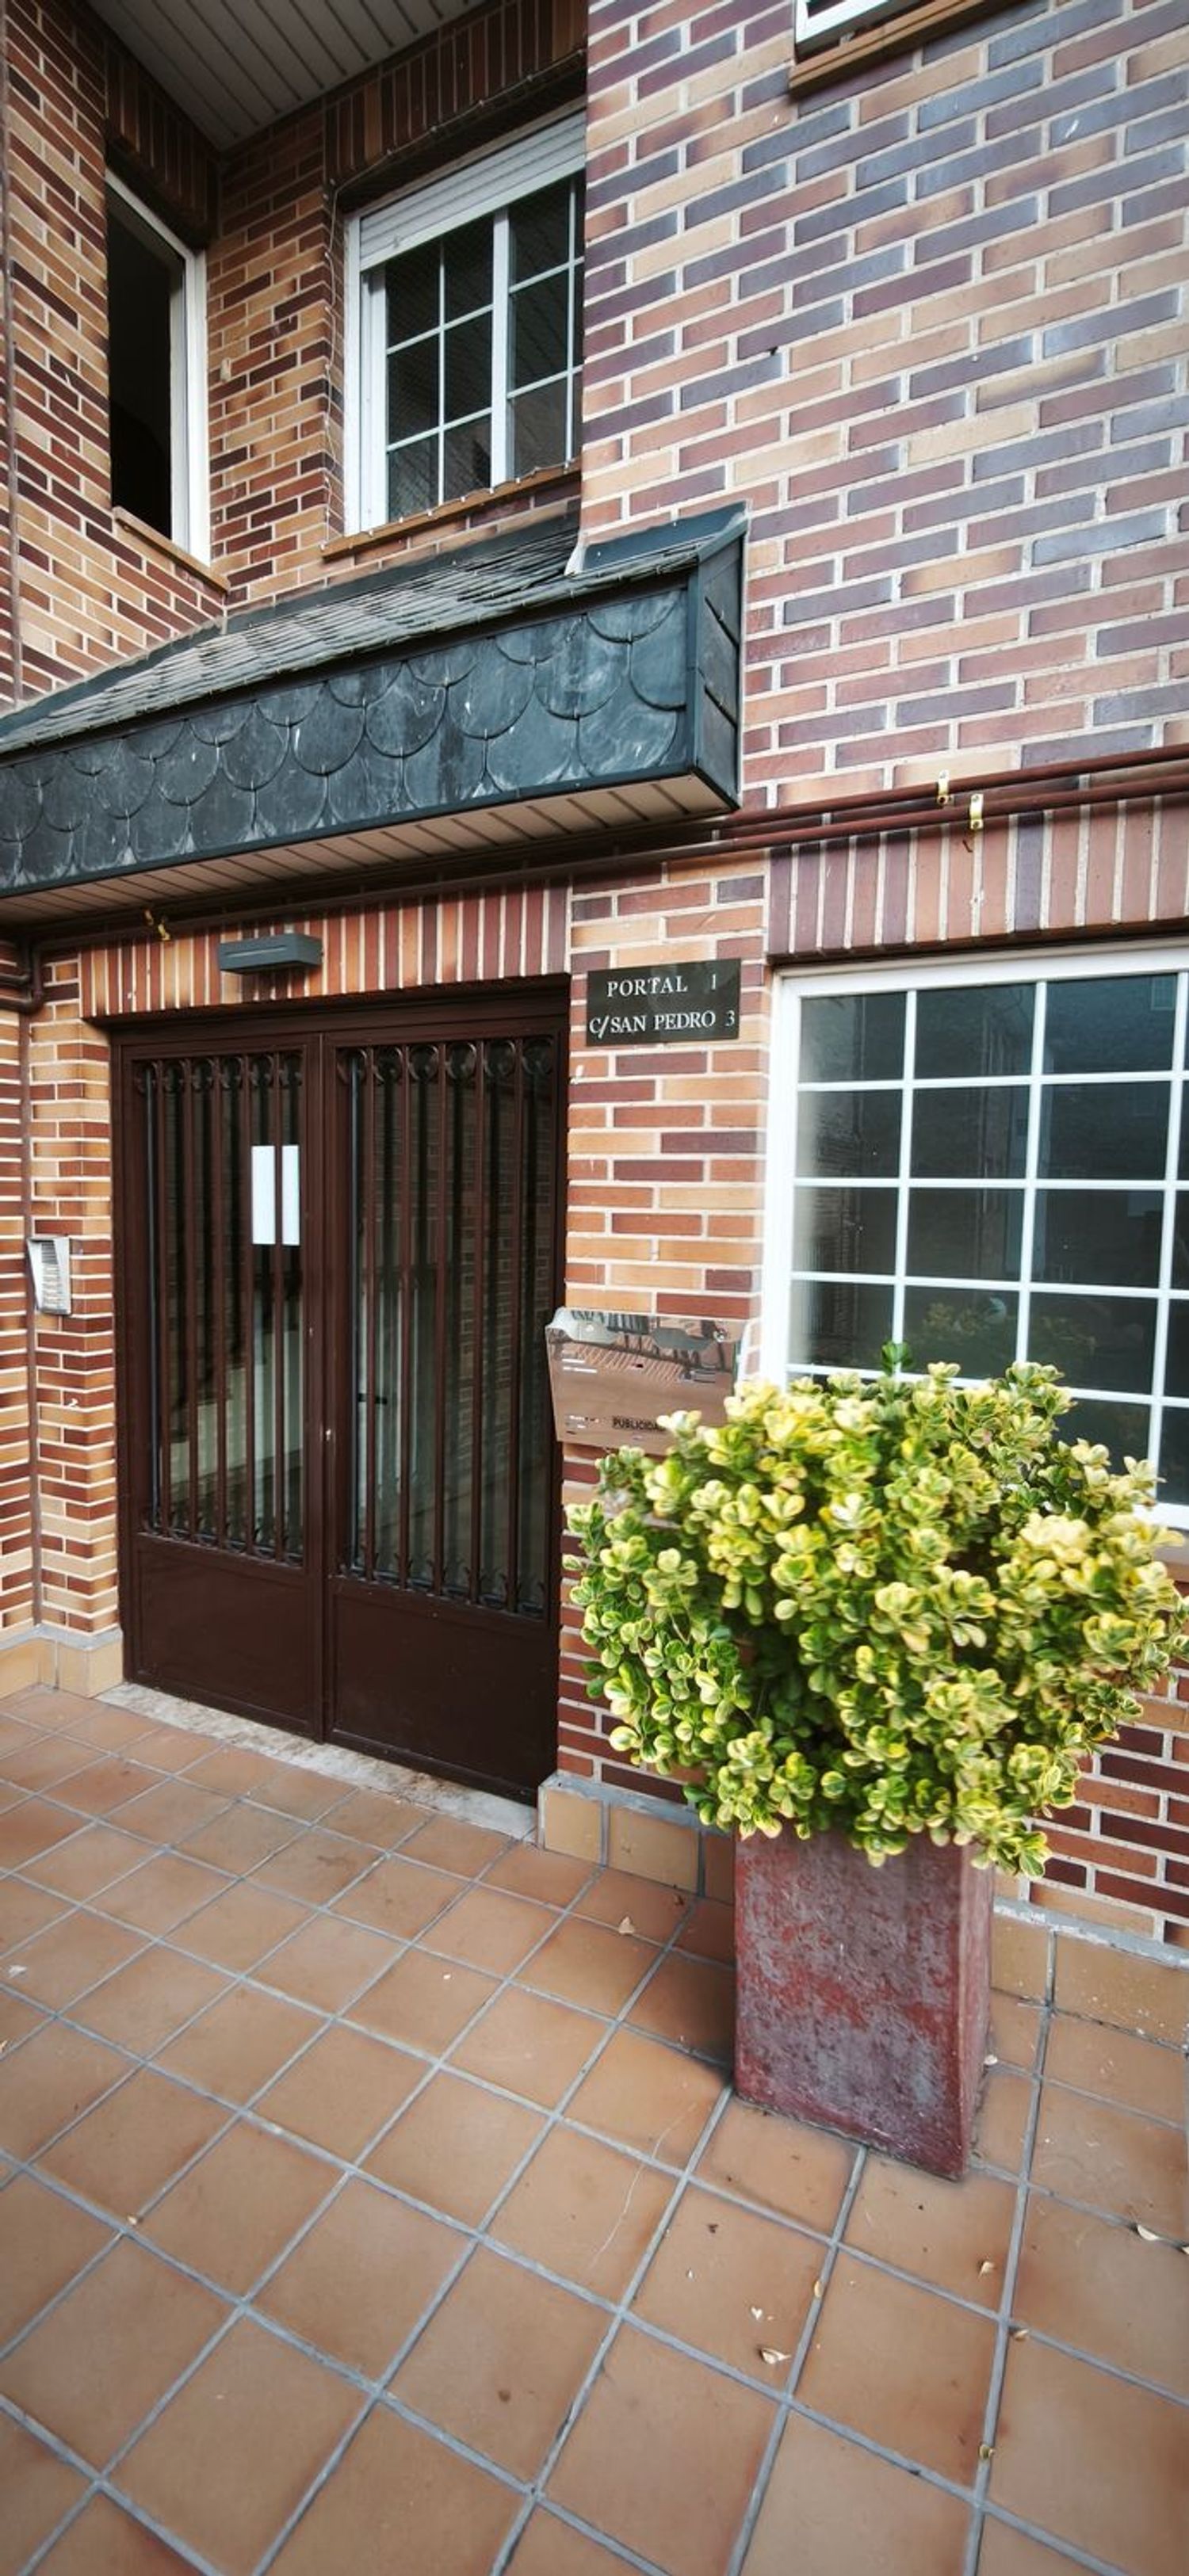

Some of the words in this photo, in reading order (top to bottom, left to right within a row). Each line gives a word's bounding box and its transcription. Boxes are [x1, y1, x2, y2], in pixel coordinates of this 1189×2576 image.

[607, 975, 688, 997] PORTAL
[654, 1010, 716, 1030] PEDRO
[725, 1010, 736, 1027] 3
[613, 1416, 666, 1432] PUBLICIDA
